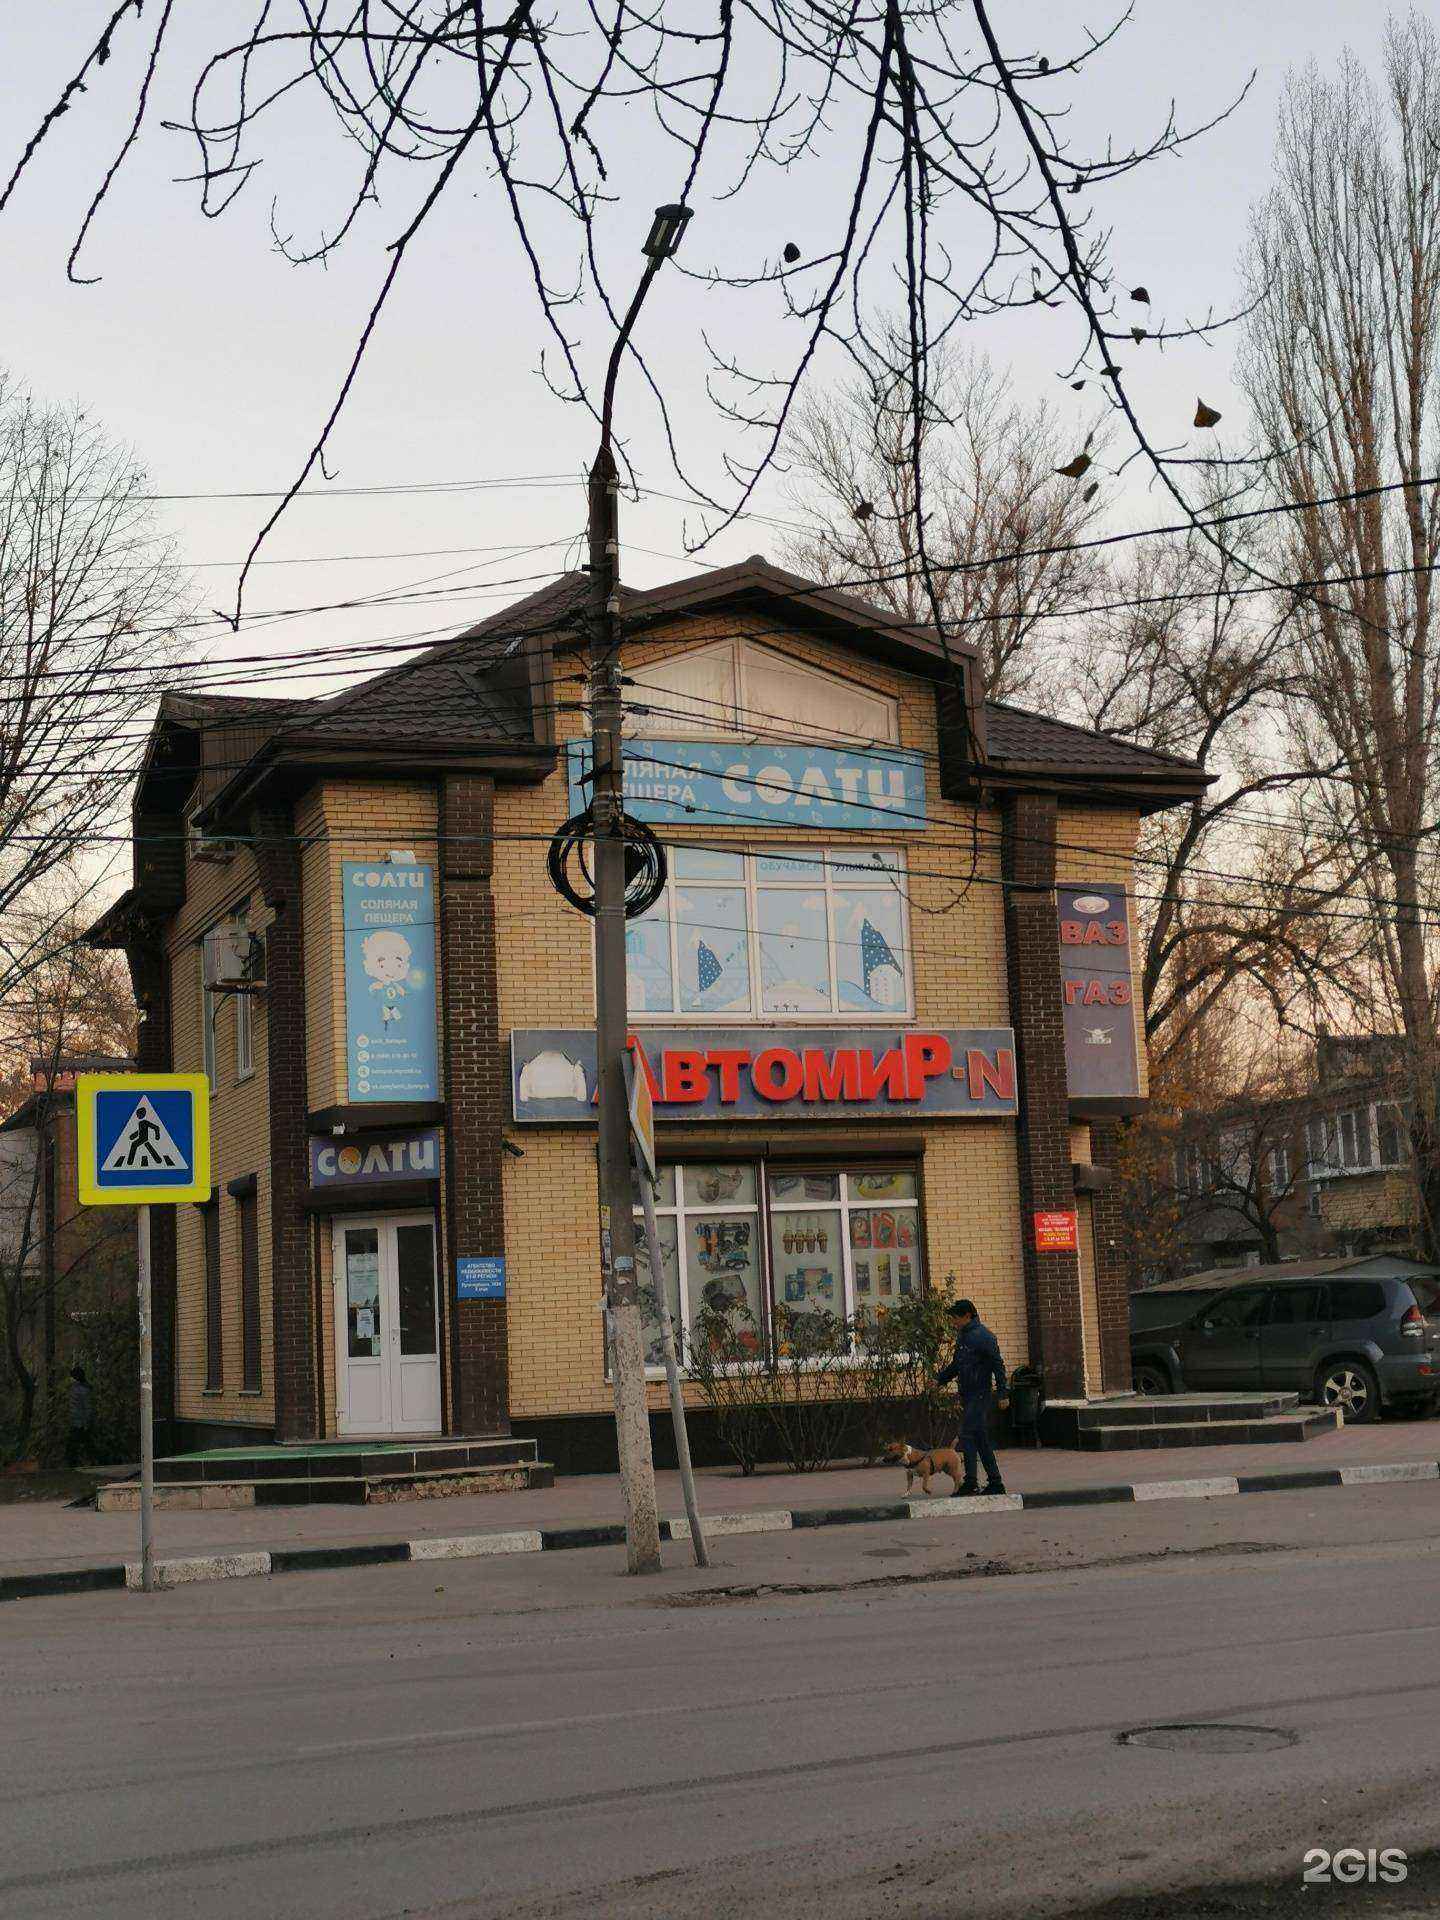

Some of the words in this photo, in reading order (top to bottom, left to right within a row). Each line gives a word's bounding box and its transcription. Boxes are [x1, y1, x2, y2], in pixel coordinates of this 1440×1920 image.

[622, 759, 703, 780] ЛЯНАЯ
[622, 782, 697, 803] ЩЕРА
[360, 899, 419, 911] СОЛЯНАЯ
[364, 911, 415, 925] ПЕЩЕРА
[1061, 920, 1129, 946] ВАЗ
[1065, 979, 1132, 1006] ГАЗ
